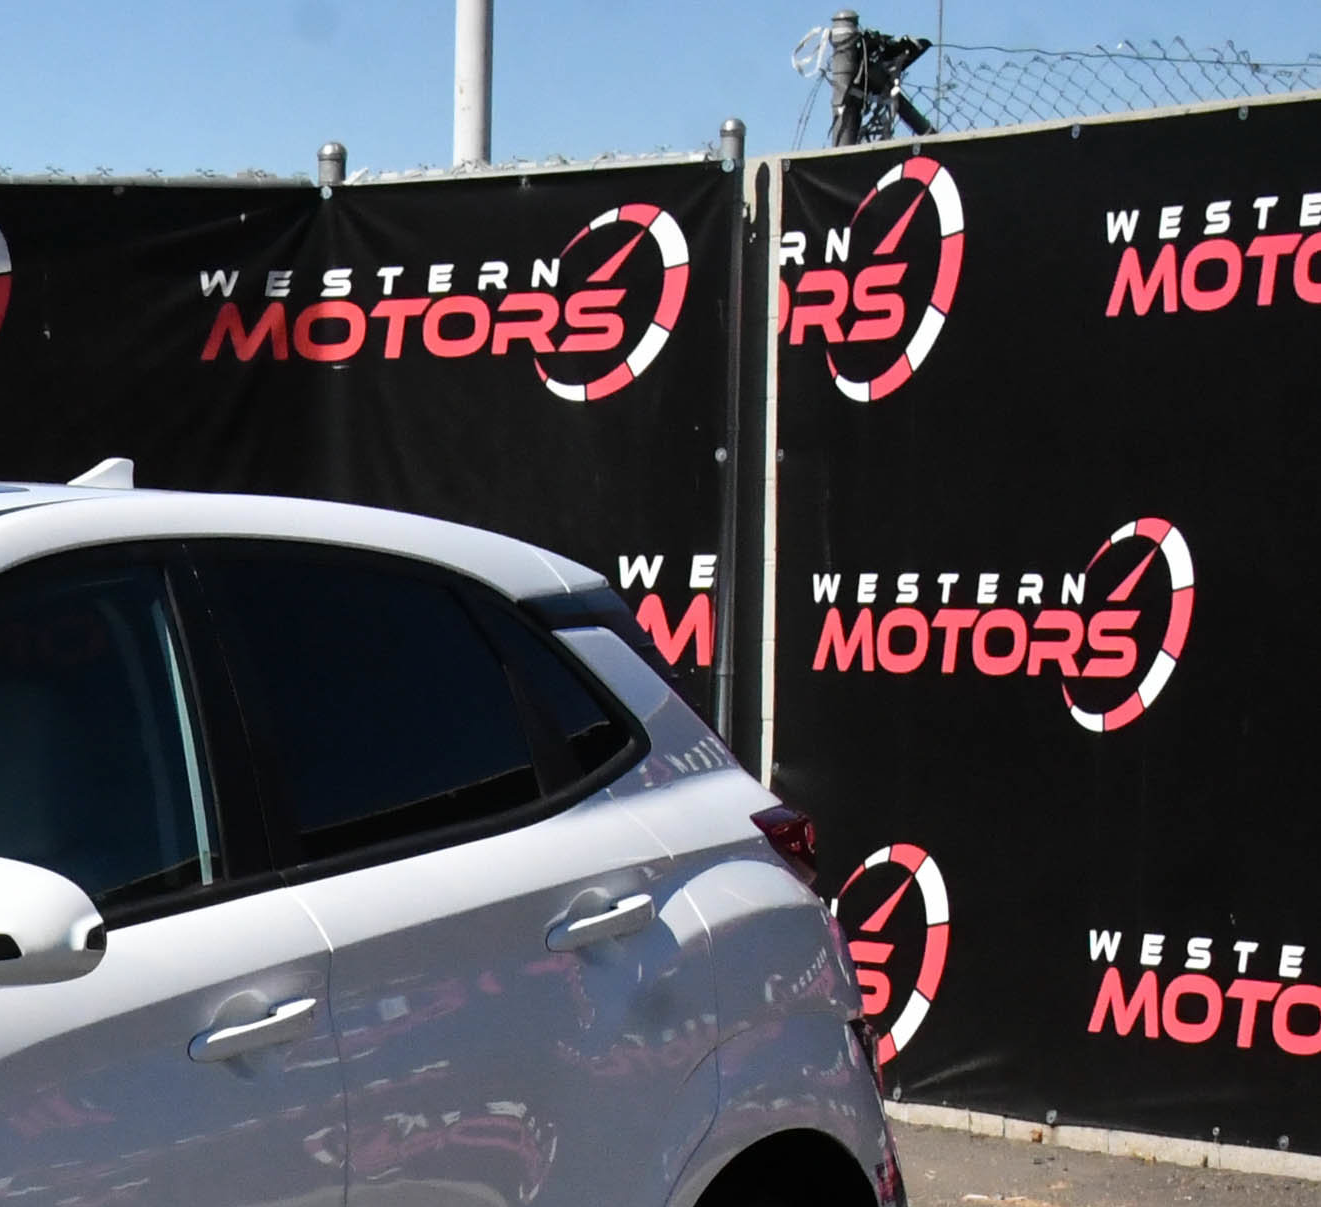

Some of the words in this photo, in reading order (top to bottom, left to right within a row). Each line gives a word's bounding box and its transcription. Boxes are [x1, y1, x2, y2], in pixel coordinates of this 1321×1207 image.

[200, 257, 561, 298] WESTERN
[201, 288, 627, 362] MOTORS
[813, 573, 1086, 605] WESTERN
[812, 606, 1142, 678] MOTORS
[1089, 930, 1306, 979] WESTE
